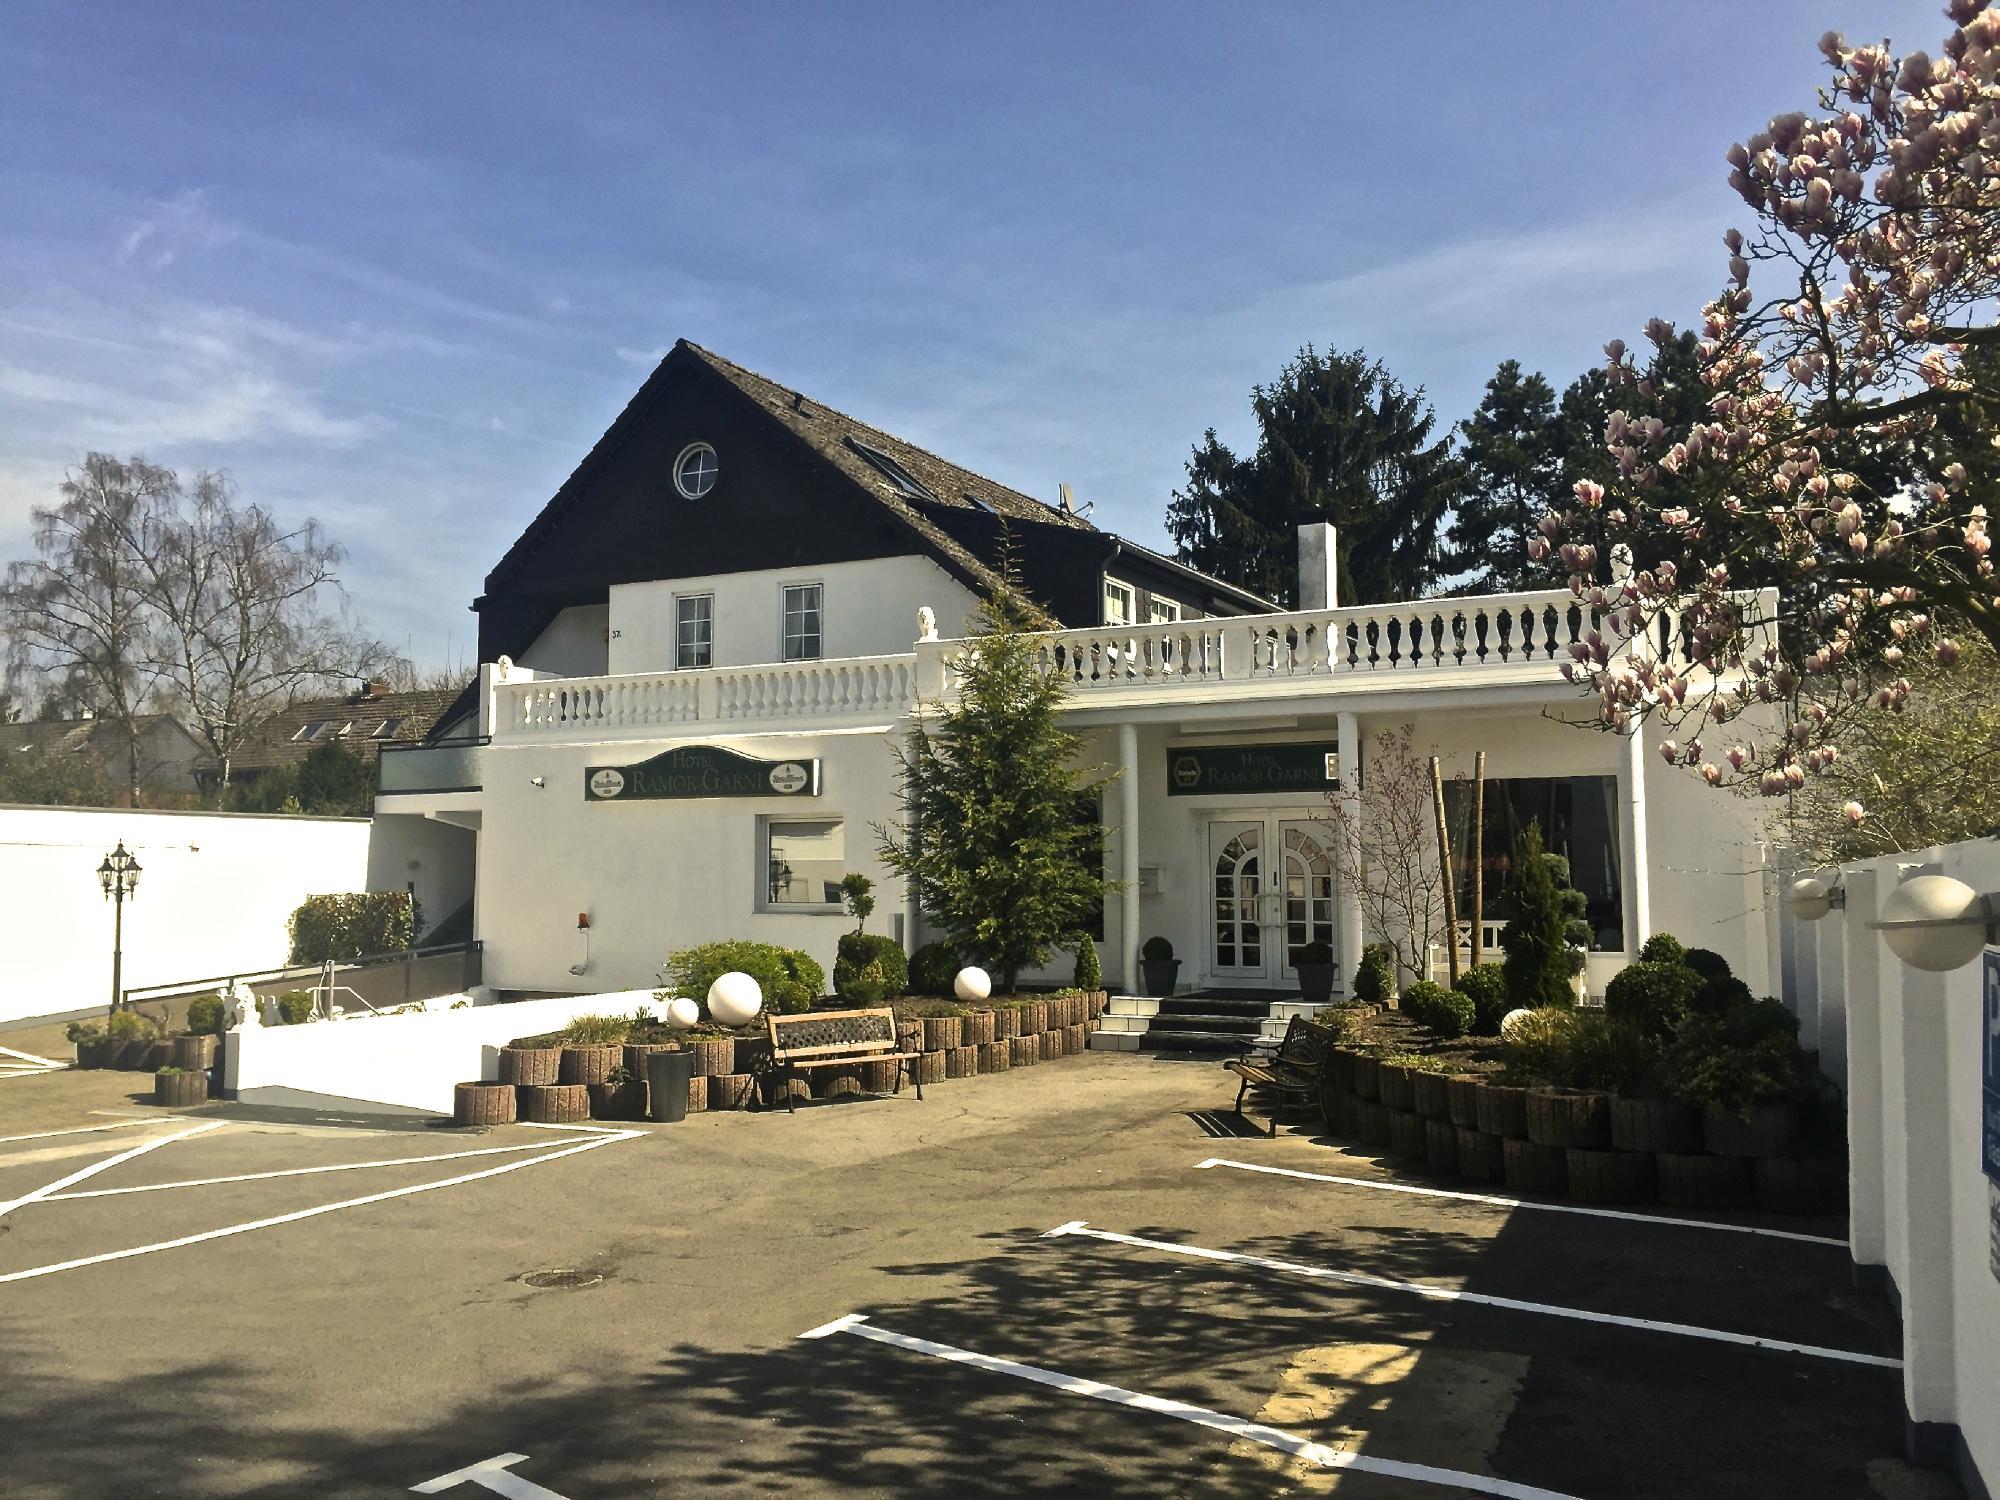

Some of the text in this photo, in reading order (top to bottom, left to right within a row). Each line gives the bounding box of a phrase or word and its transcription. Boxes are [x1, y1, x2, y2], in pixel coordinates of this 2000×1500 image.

[673, 752, 713, 769] HOTEL
[702, 768, 764, 791] GARNI
[1267, 764, 1318, 783] GARNI
